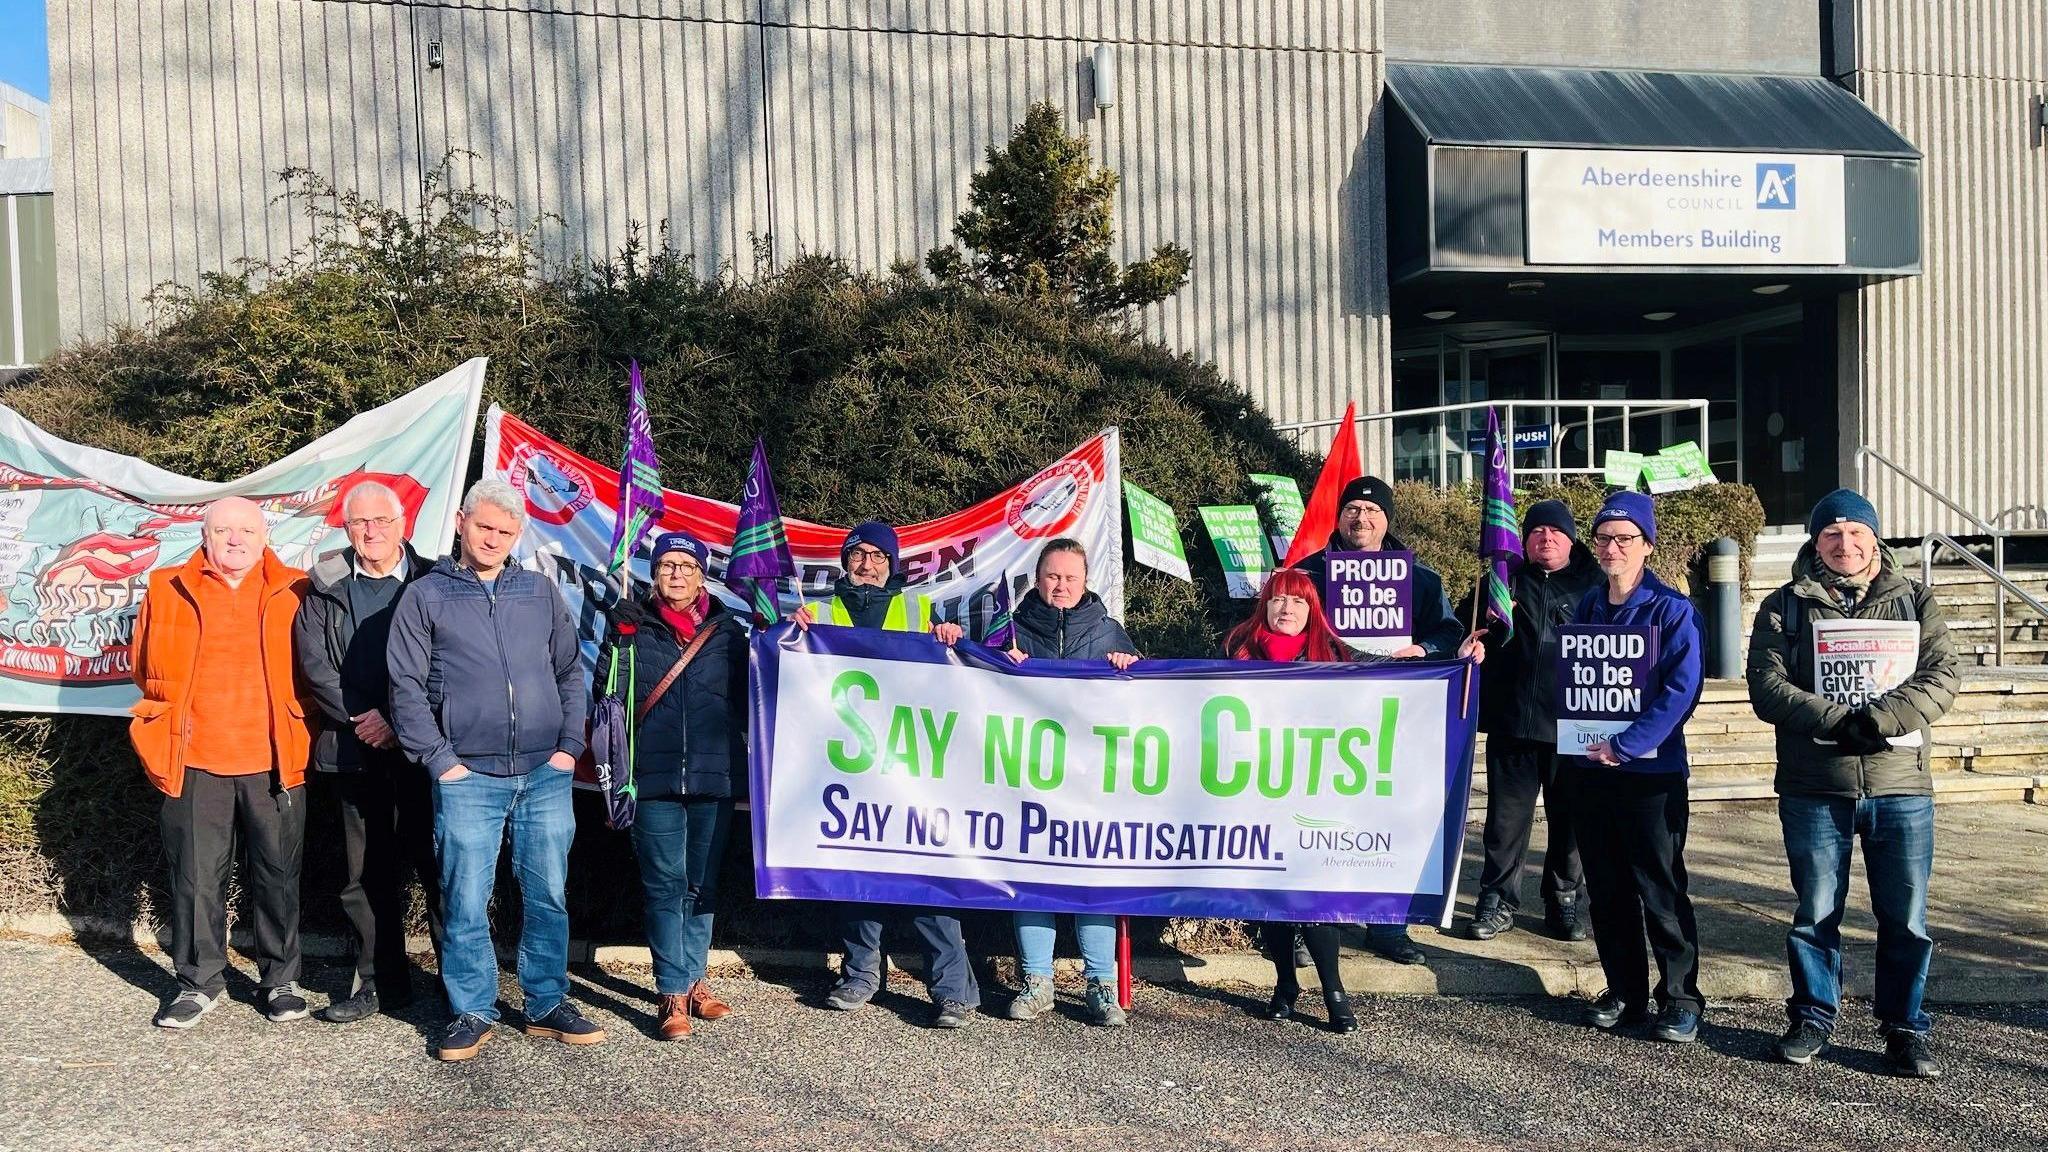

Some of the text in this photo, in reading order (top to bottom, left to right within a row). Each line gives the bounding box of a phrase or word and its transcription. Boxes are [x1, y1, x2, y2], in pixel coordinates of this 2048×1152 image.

[1582, 166, 1742, 188] Aberdeenshire
[1667, 198, 1743, 210] COUNCIL
[1598, 229, 1782, 254] Members Building
[1514, 430, 1547, 443] PUSH
[1209, 525, 1222, 536] to
[1224, 523, 1239, 536] be
[1240, 522, 1254, 536] in
[1221, 538, 1263, 551] TRADE
[1228, 553, 1266, 568] UNION
[1330, 558, 1408, 582] PROUD
[1341, 583, 1397, 606] to be
[1334, 607, 1404, 630] UNION
[1561, 634, 1645, 659] PROUD
[1827, 640, 1878, 652] Socialist
[1572, 661, 1633, 686] to be
[1820, 660, 1877, 676] DON'T
[1822, 676, 1865, 692] GIVE
[1565, 687, 1641, 713] UNION
[984, 714, 1066, 790] NO
[1093, 725, 1170, 795] TO
[905, 806, 950, 847] NO
[964, 810, 1005, 851] TO
[1299, 830, 1391, 852] UNISON
[1321, 856, 1395, 868] Aberdeenshire
